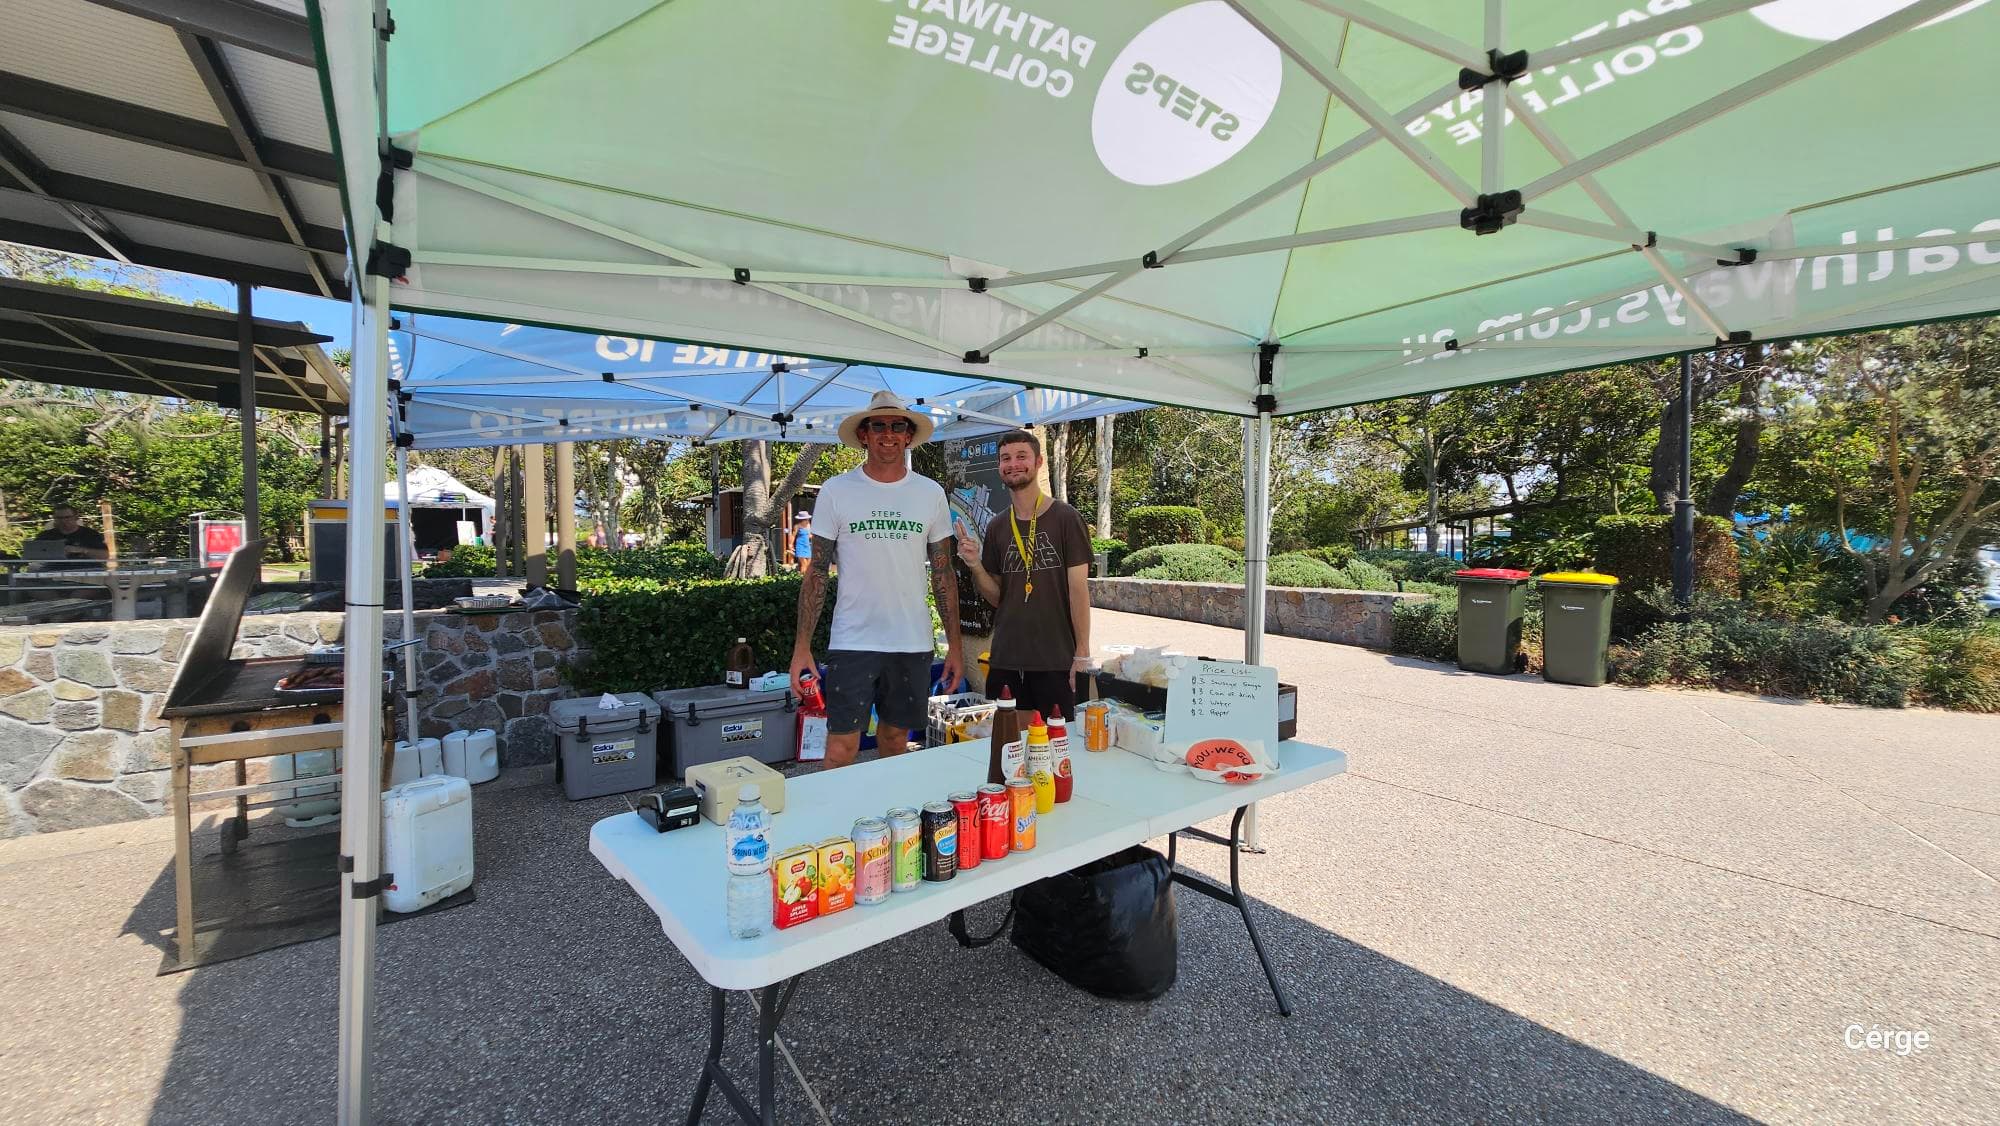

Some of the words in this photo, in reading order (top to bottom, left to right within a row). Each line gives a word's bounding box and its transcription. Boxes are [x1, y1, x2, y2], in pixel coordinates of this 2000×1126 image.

[871, 510, 902, 518] STEPS
[849, 519, 923, 533] PATHWAYS
[865, 532, 908, 540] COLLEGE
[1202, 664, 1226, 673] Price
[1231, 667, 1250, 675] List
[1214, 746, 1236, 754] WE
